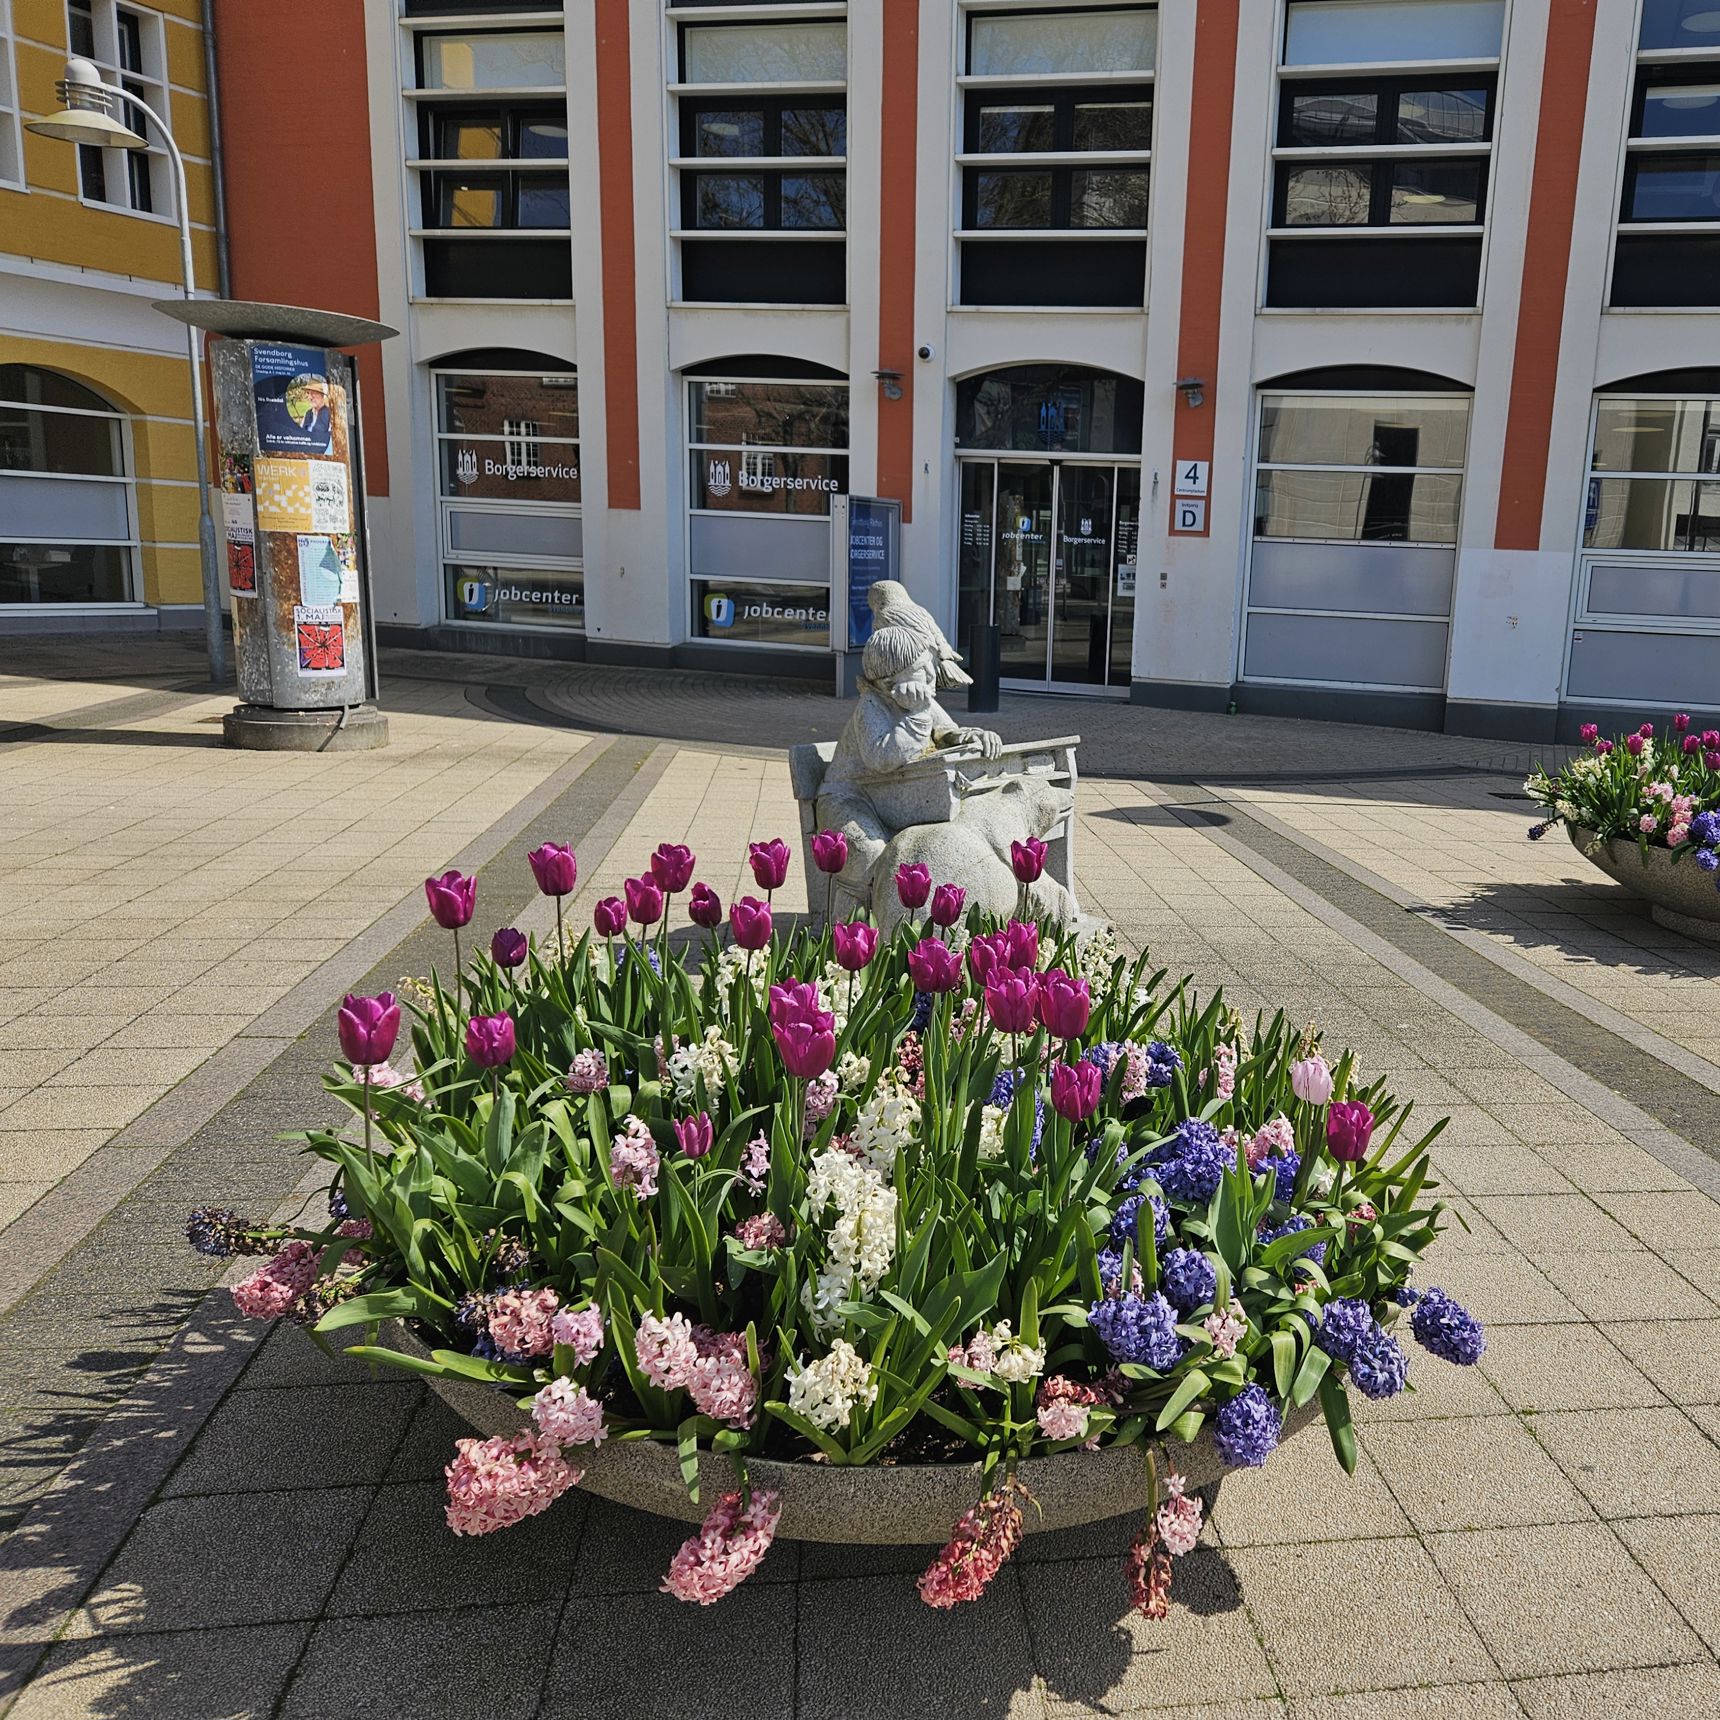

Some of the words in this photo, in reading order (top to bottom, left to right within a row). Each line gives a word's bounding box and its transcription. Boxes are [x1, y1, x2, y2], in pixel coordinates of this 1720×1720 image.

[254, 348, 292, 359] Svendborg
[254, 356, 309, 367] Forsamlingshus
[257, 464, 297, 478] WERK
[485, 459, 578, 480] Borgerservice
[1184, 463, 1200, 485] 4
[738, 470, 838, 492] Borgerservice
[1182, 510, 1197, 527] D
[1002, 532, 1043, 540] jobcenter
[1063, 535, 1106, 545] Borgerservice
[850, 549, 884, 560] ORGERSERVICE
[494, 586, 579, 604] jobcenter
[296, 607, 341, 615] SOCIALISTISK
[743, 602, 831, 621] jobcente
